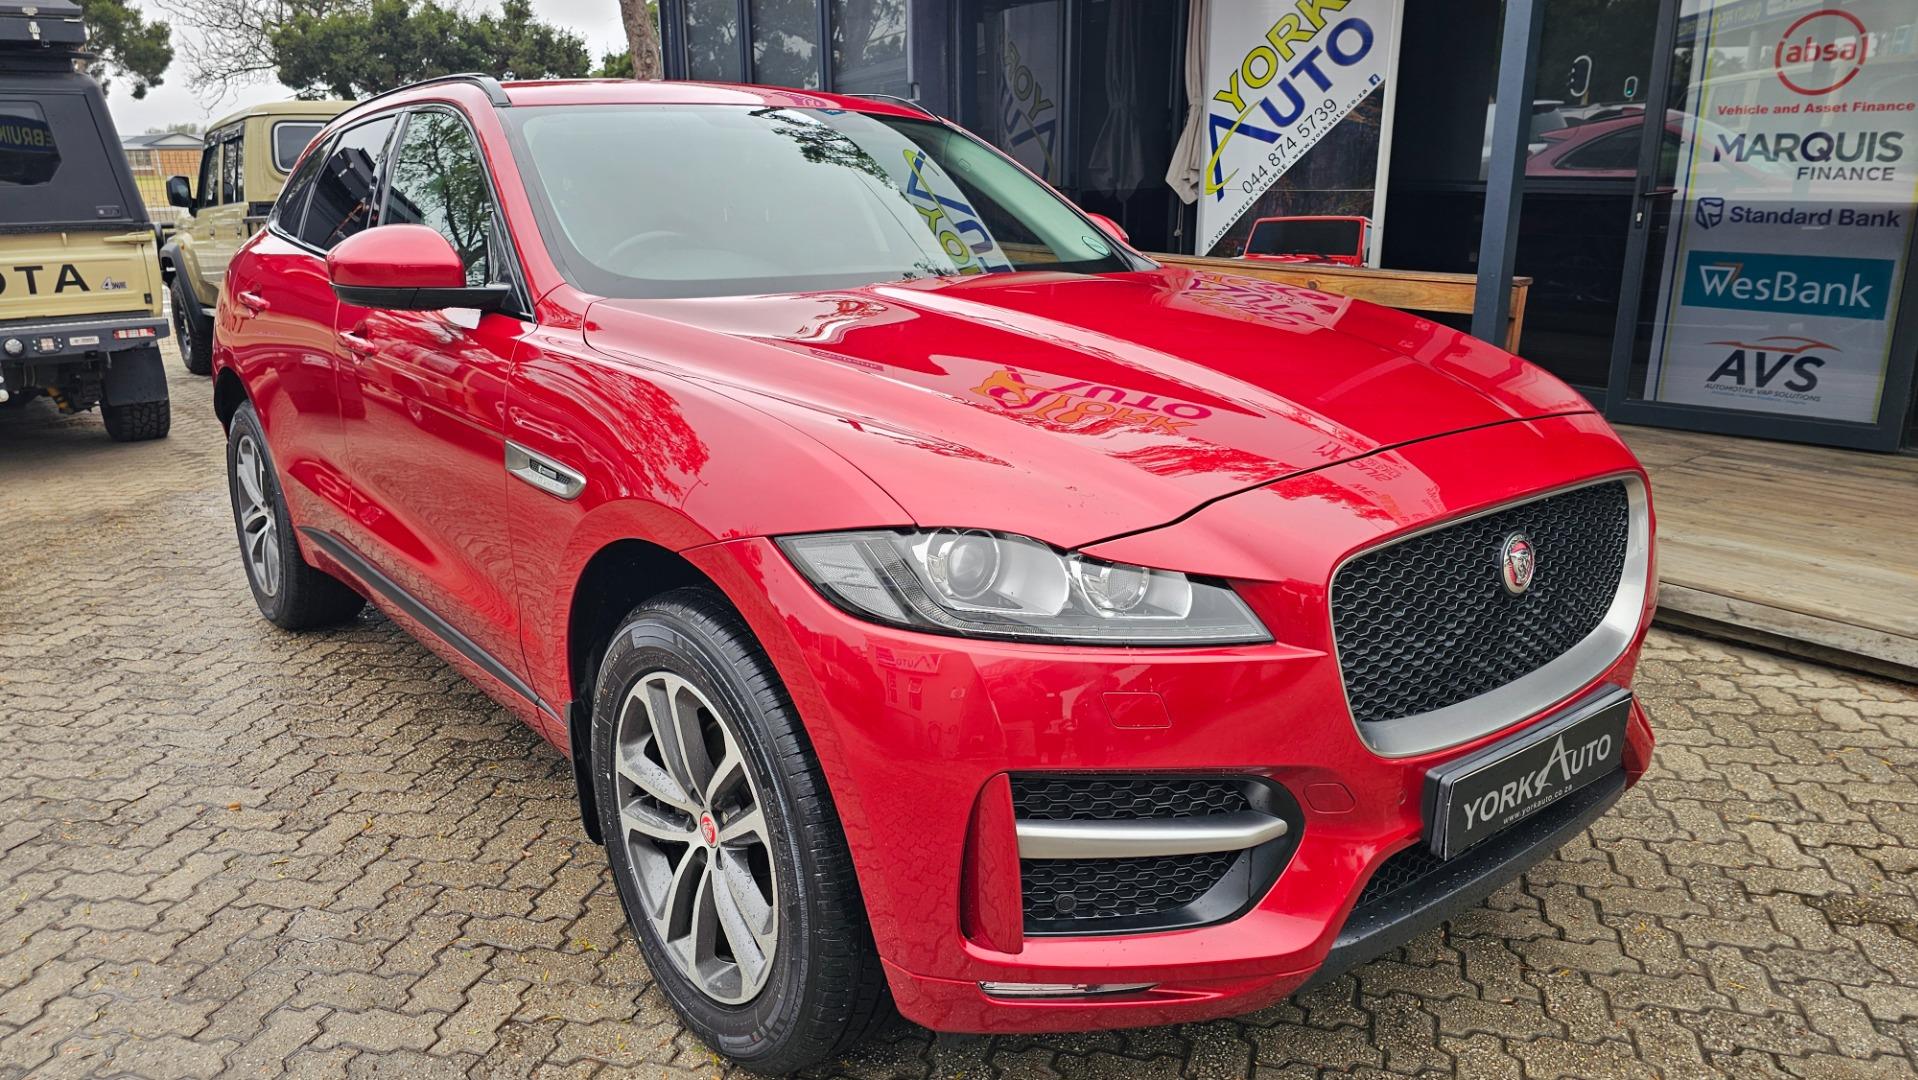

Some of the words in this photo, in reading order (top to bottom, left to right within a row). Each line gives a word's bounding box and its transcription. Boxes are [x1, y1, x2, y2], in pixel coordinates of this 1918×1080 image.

[1213, 0, 1351, 114] YORK
[1786, 36, 1857, 63] absa
[1207, 17, 1374, 202] AUTO
[1718, 105, 1769, 116] Vehicle
[1773, 103, 1800, 114] and
[1804, 102, 1848, 113] Asset
[1852, 101, 1916, 112] Finance
[1214, 222, 1230, 239] YORK
[1231, 196, 1254, 222] STREET
[1259, 164, 1288, 192] GEORGE
[1292, 89, 1368, 159] www.yorkauto.co.za
[1242, 165, 1269, 194] 044
[1268, 136, 1297, 167] 874
[1297, 98, 1337, 138] 5739
[1713, 131, 1905, 163] MARQUIS
[1796, 166, 1896, 181] FINANCE
[1729, 206, 1833, 226] Standard
[1838, 208, 1902, 228] Bank
[0, 264, 91, 295] TA
[1699, 265, 1873, 308] WesBank
[1706, 349, 1826, 393] AVS
[1704, 383, 1754, 395] AUTOMOTIVE
[1774, 390, 1821, 402] SOLUTIONS
[1503, 784, 1573, 825] www.yorkauto.coza
